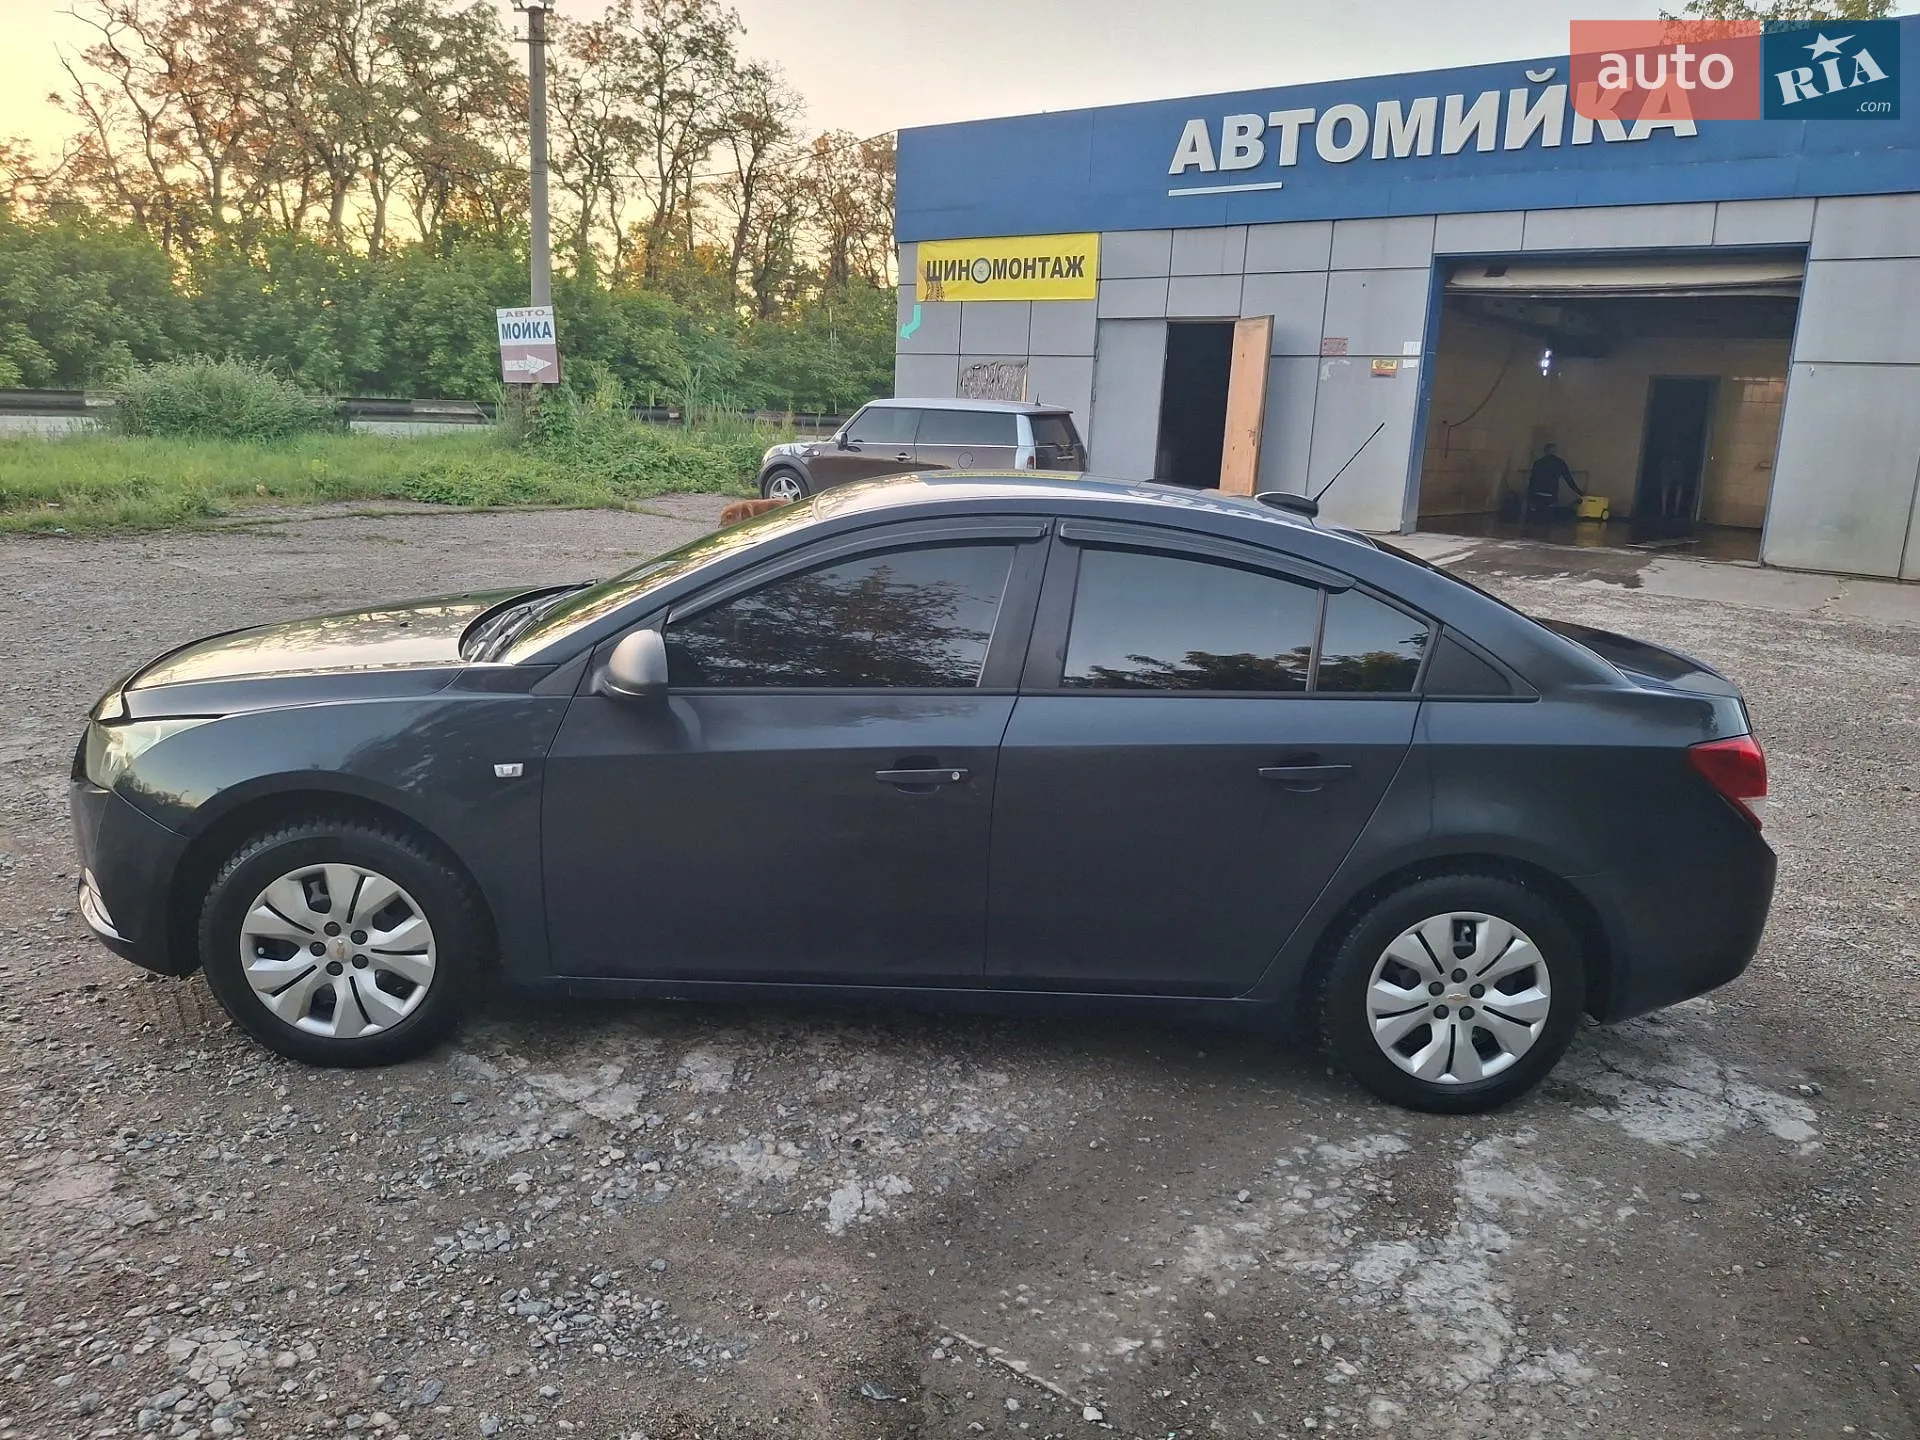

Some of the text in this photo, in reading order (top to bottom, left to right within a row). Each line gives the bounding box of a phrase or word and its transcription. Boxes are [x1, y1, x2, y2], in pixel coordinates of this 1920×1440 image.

[1168, 68, 1698, 175] АВТОМИЙКА
[926, 255, 1085, 284] ШИНОМОНТАЖ
[505, 309, 545, 318] АВТО
[501, 318, 552, 340] МОЙКА
